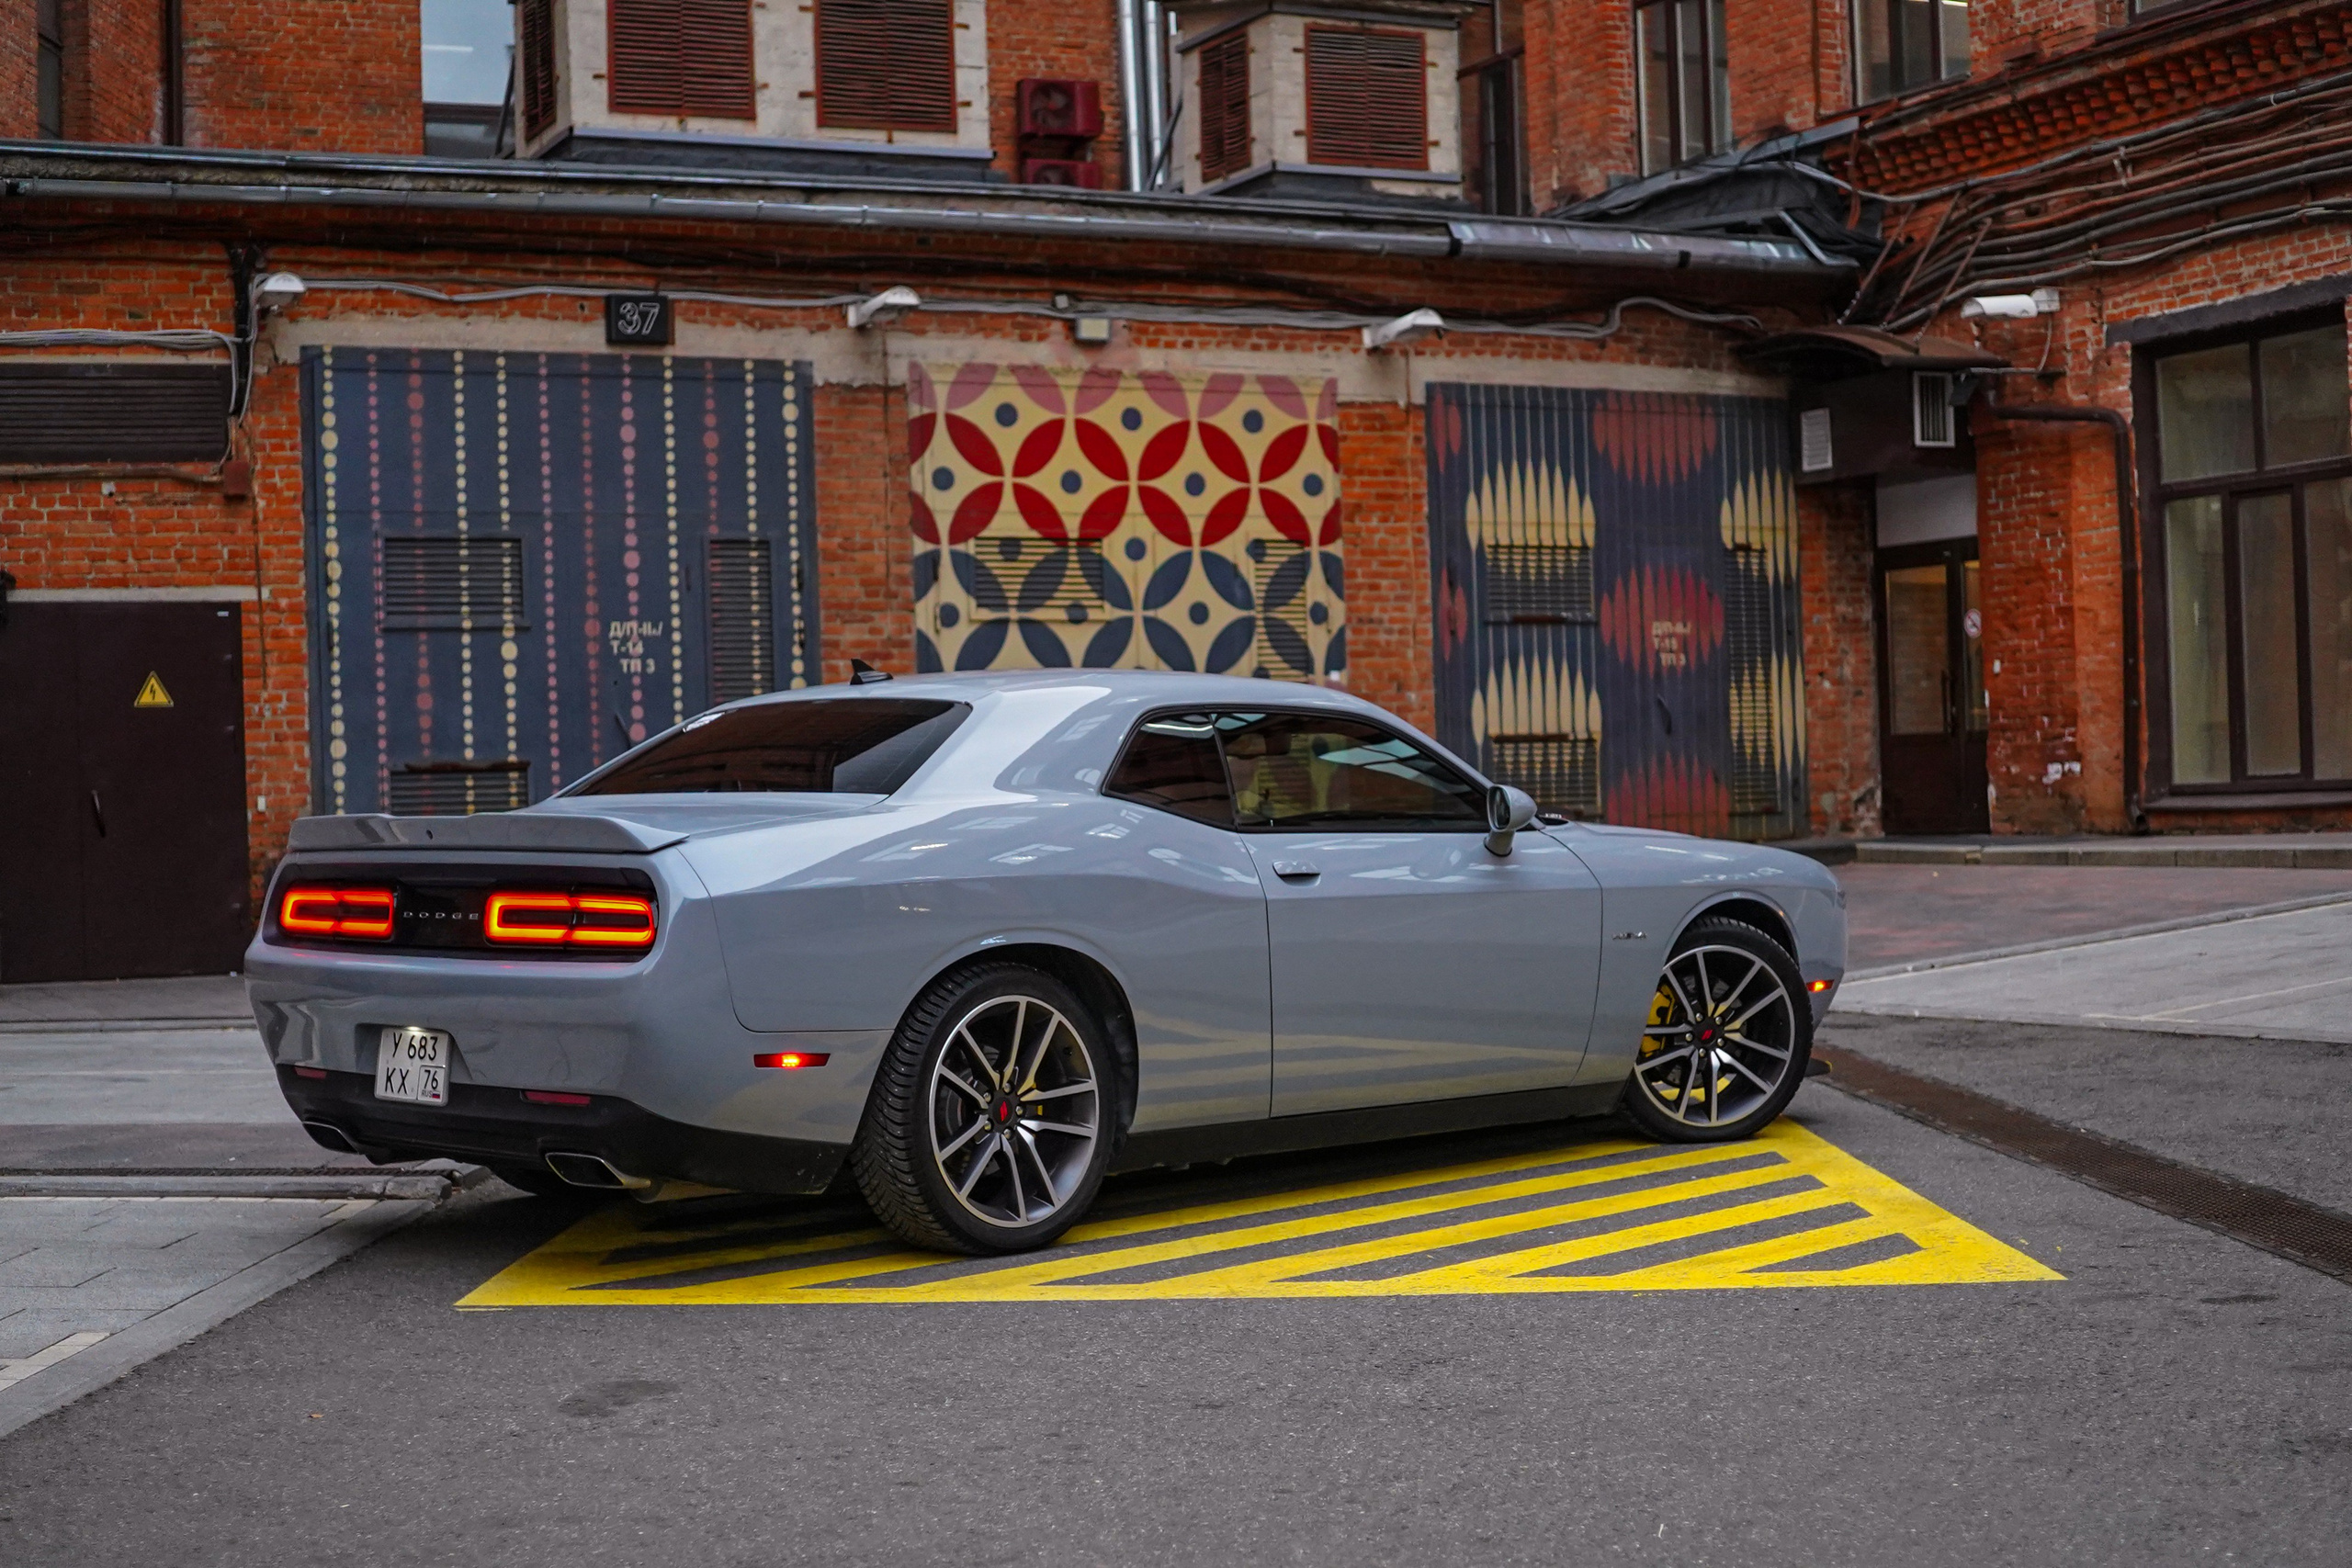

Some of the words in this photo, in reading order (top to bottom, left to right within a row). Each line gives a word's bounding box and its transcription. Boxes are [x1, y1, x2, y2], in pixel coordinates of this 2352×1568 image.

[617, 301, 661, 335] 37
[403, 911, 479, 920] DODGE
[407, 1034, 439, 1061] 683
[424, 1069, 439, 1090] 76
[421, 1089, 433, 1099] RUS
